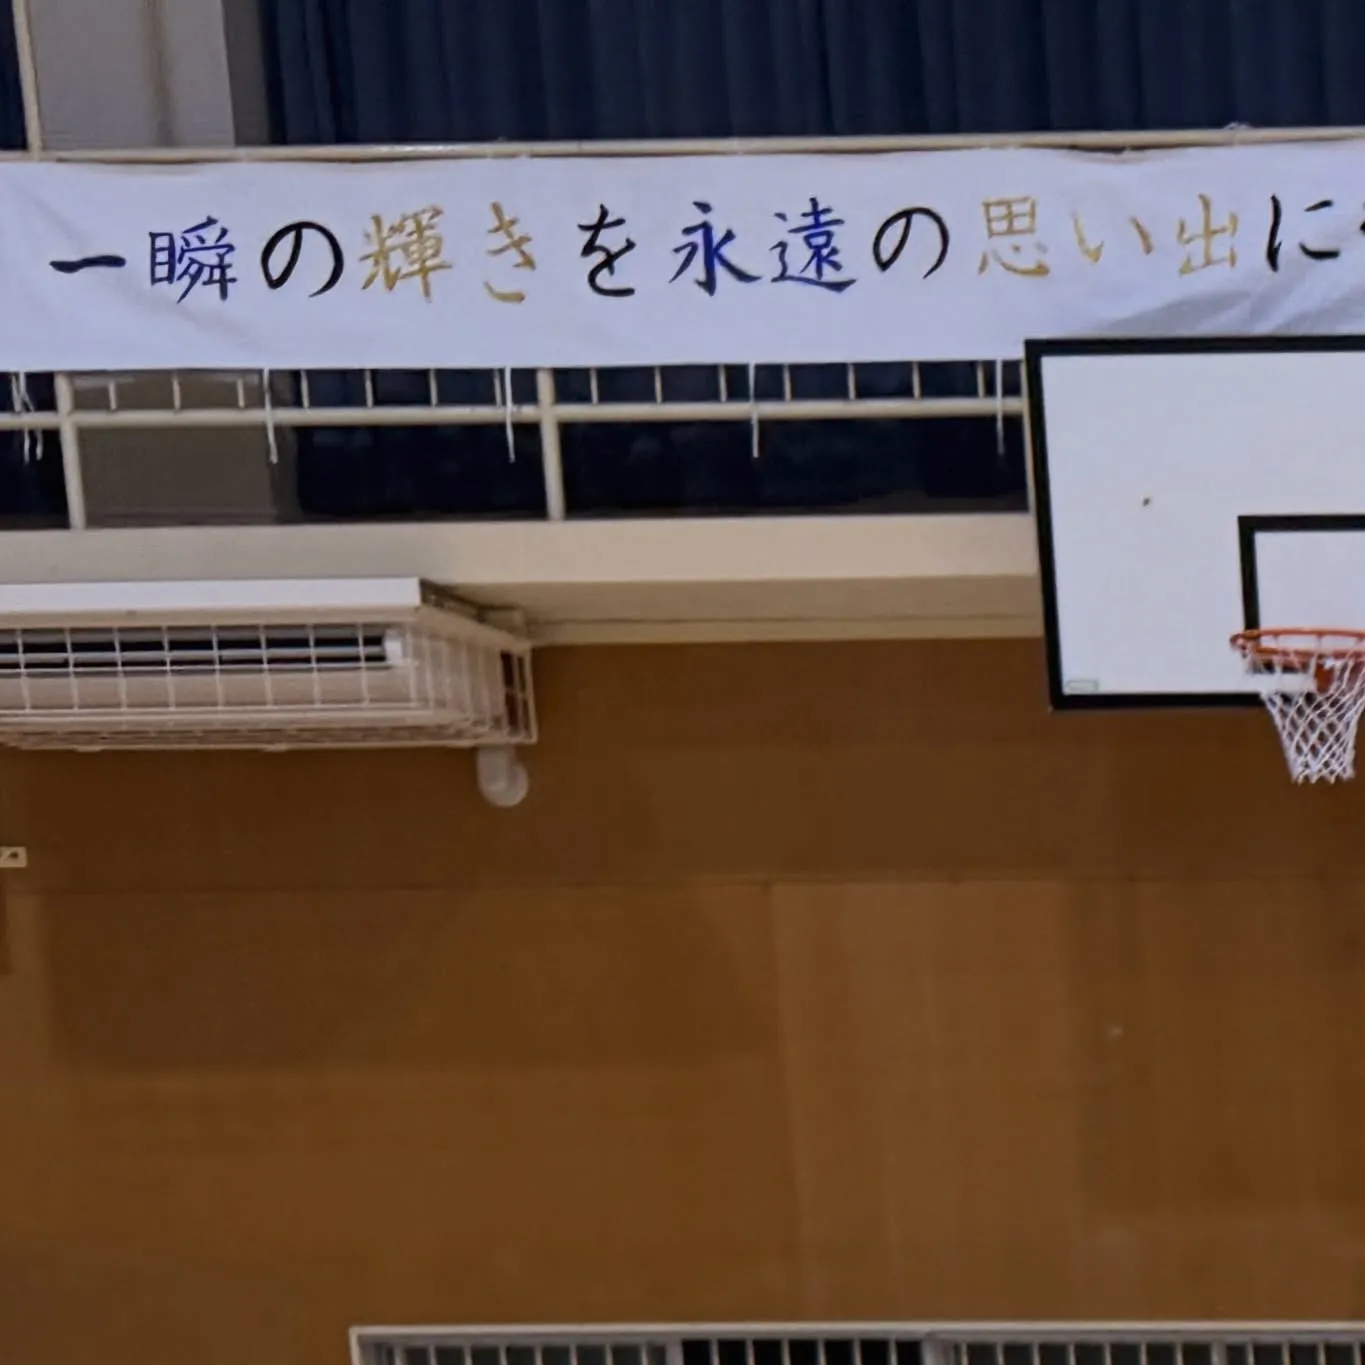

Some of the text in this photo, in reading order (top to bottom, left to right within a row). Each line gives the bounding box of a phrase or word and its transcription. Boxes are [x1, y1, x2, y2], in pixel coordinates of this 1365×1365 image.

[48, 194, 1341, 304] 一瞬の輝きを永遠の思い出に
